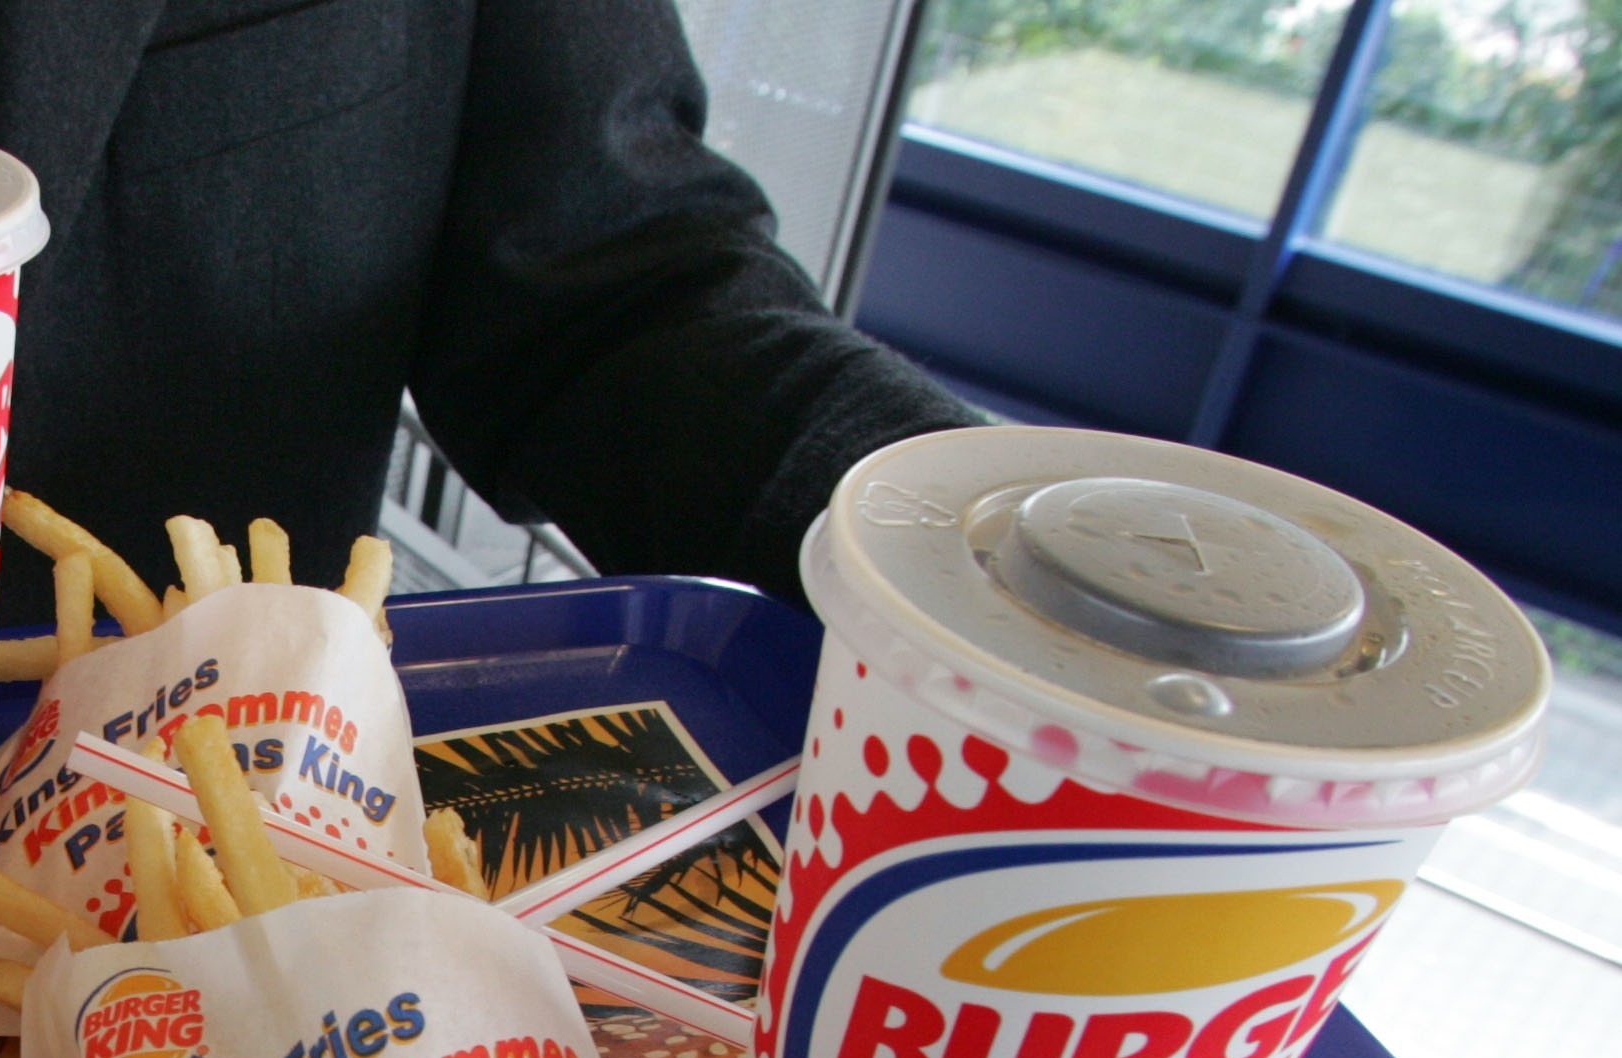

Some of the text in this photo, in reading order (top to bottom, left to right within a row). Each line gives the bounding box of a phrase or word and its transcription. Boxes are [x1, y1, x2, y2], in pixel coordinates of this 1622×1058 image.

[104, 658, 219, 744] Fries
[298, 734, 397, 826] King
[83, 989, 202, 1041] BURGER
